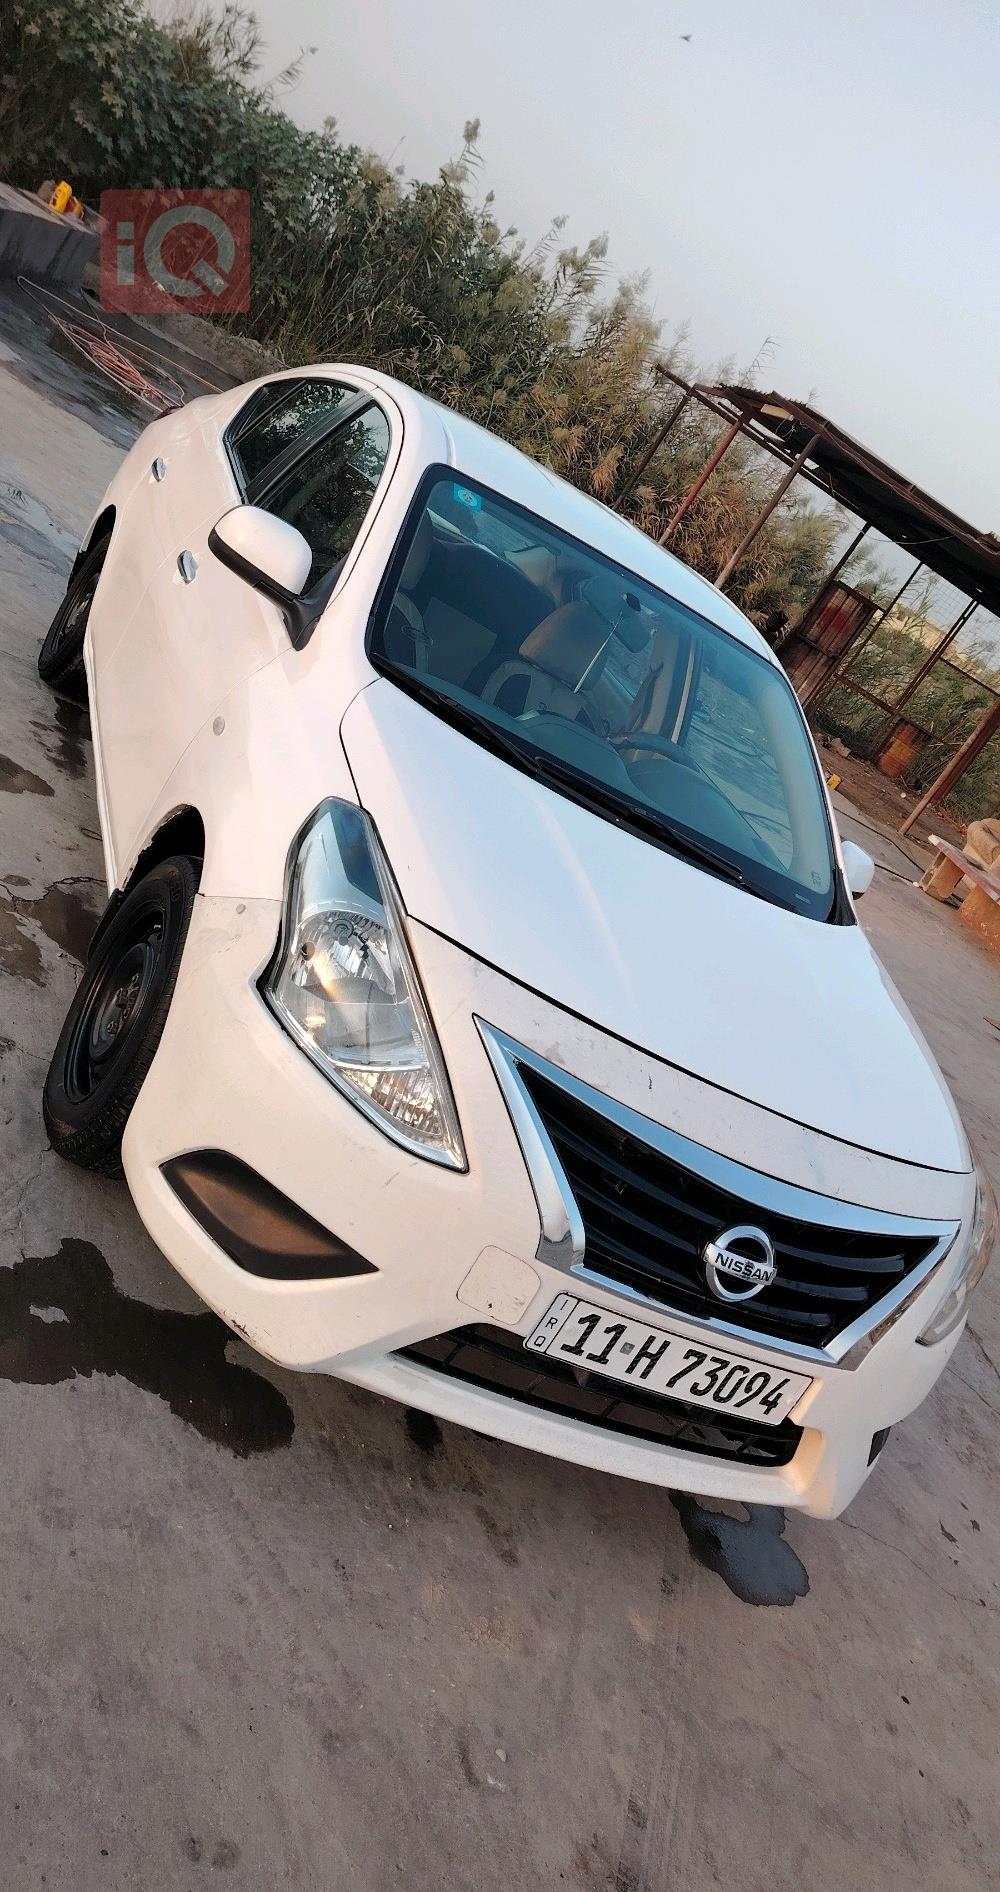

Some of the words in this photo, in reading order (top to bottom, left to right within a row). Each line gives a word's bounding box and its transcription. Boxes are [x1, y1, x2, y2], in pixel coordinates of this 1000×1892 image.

[714, 1252, 773, 1282] NISSAN
[533, 1299, 569, 1348] IRQ
[560, 1313, 628, 1365] 11
[625, 1335, 671, 1380] H
[665, 1348, 791, 1415] 73094
